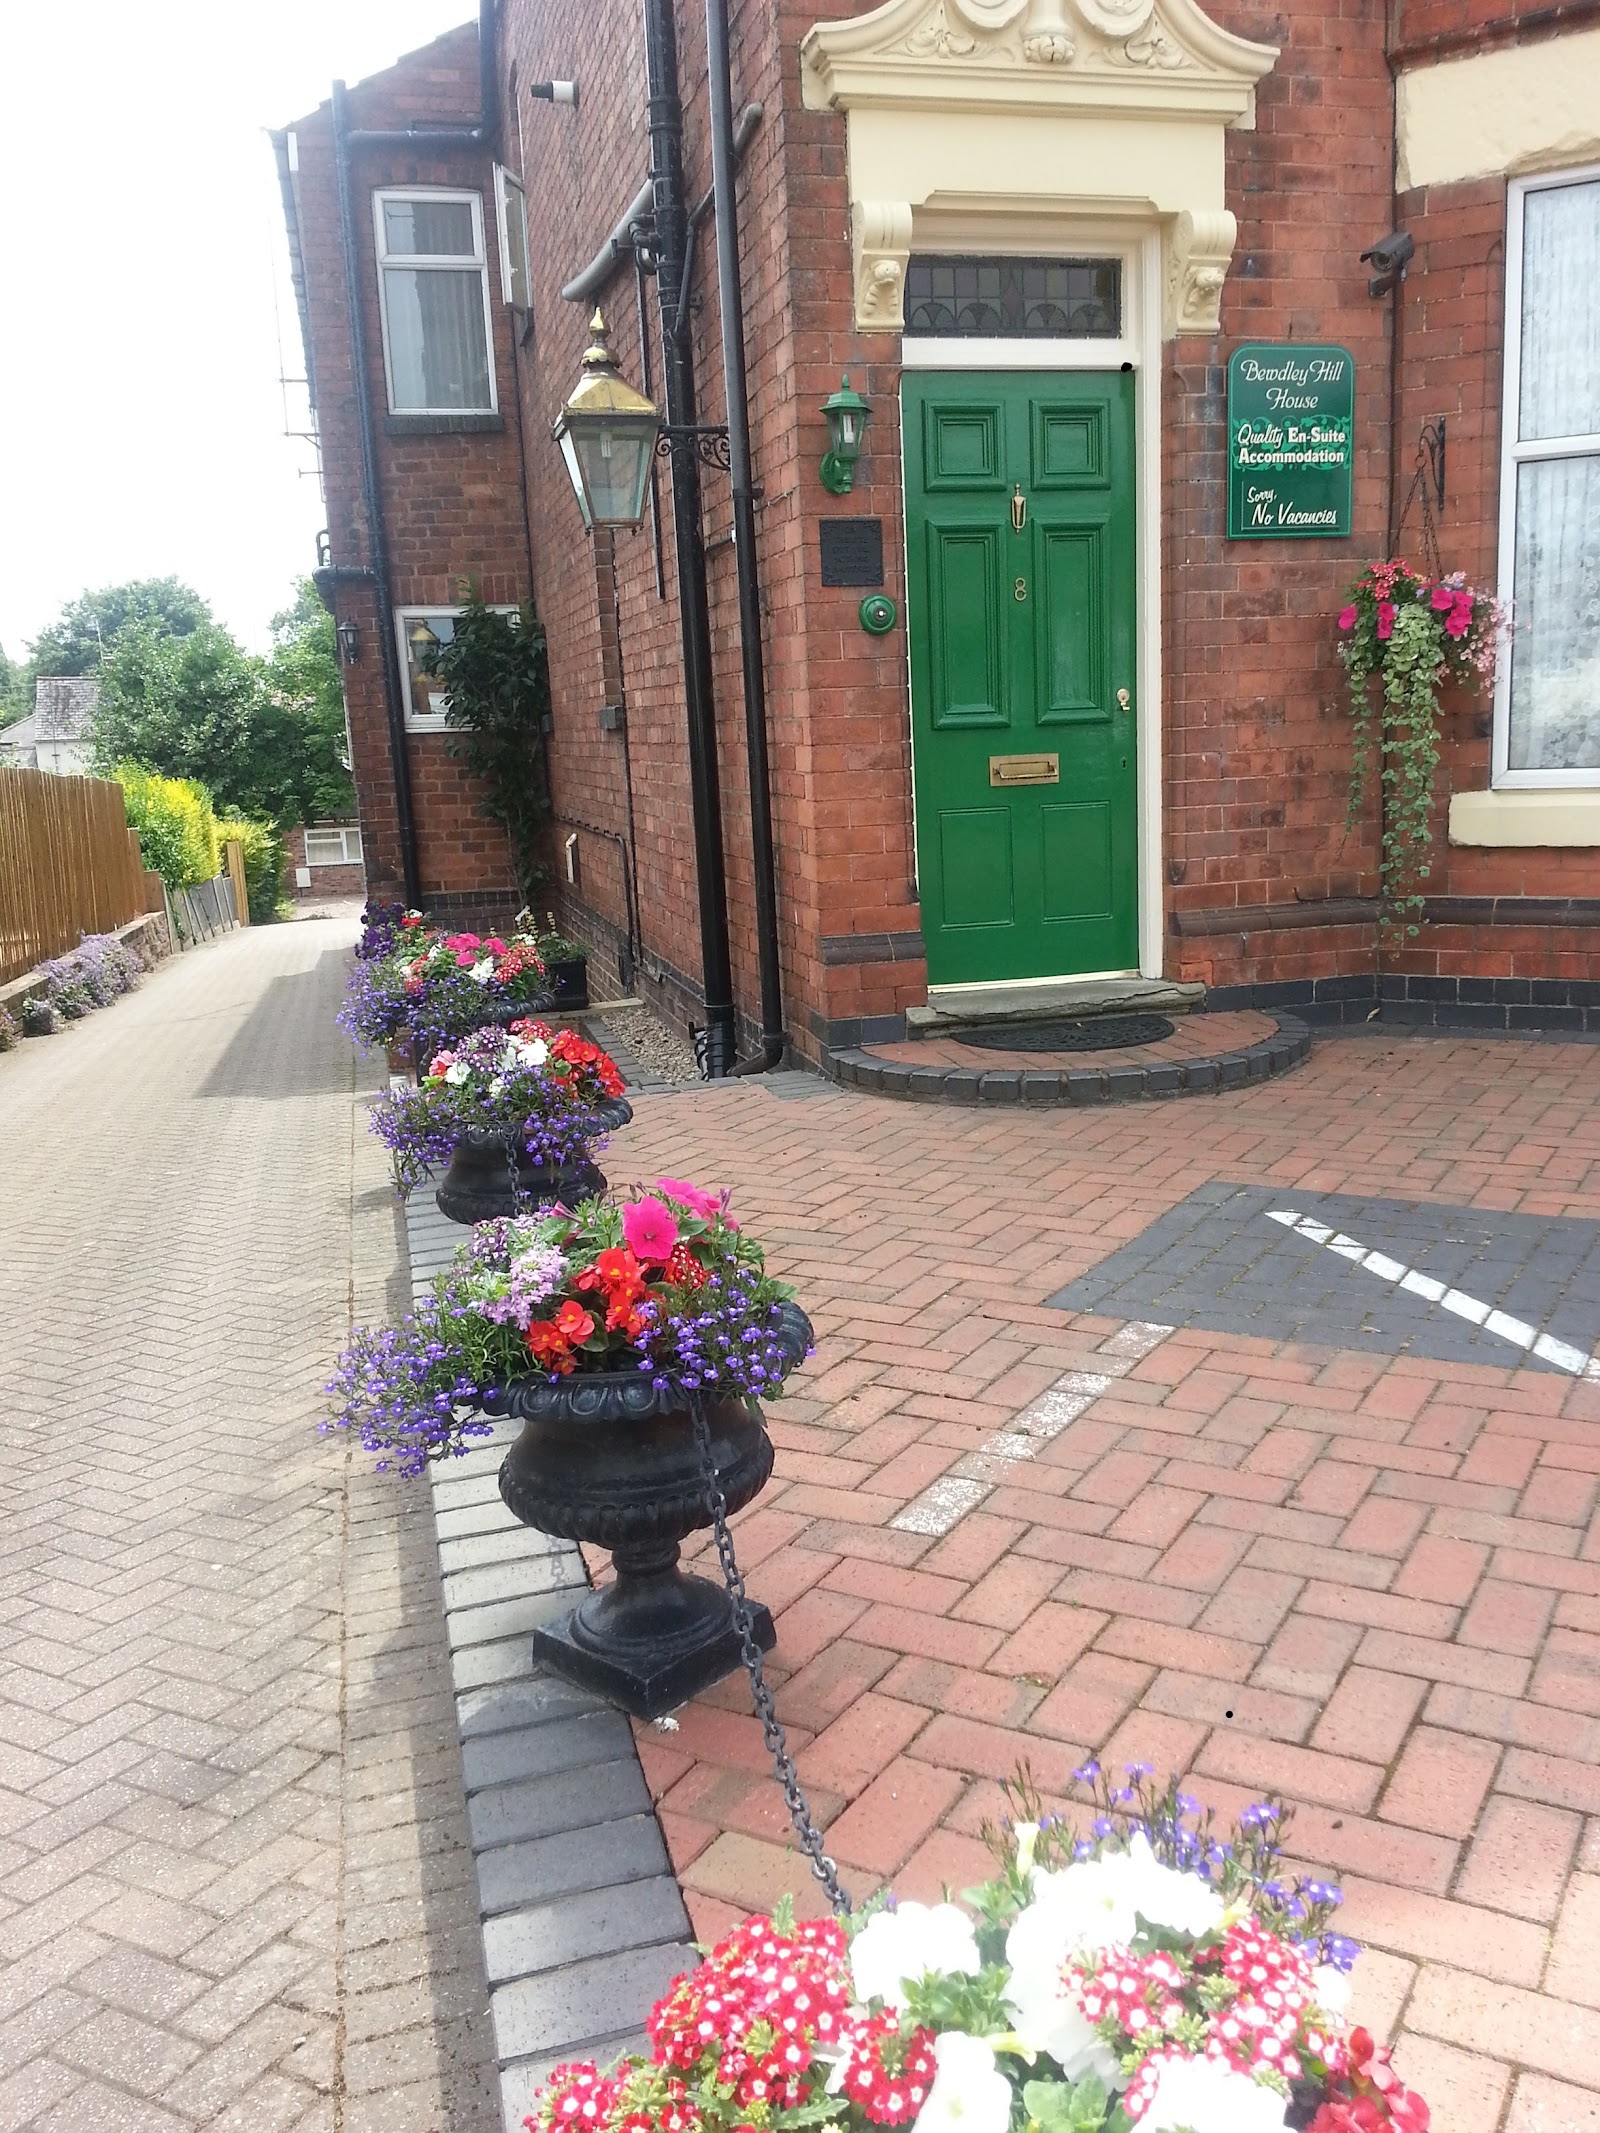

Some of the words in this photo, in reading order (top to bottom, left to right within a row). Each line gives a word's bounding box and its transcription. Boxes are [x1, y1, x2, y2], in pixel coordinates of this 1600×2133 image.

[1240, 359, 1308, 386] Bewdley
[1309, 360, 1345, 383] Hill
[1266, 388, 1319, 410] House
[1238, 424, 1284, 449] Quality
[1288, 427, 1345, 443] En-Suite
[1238, 448, 1344, 464] Accommodation
[1252, 503, 1274, 525] No
[1278, 502, 1337, 525] Vacancies
[1014, 577, 1027, 601] 8
